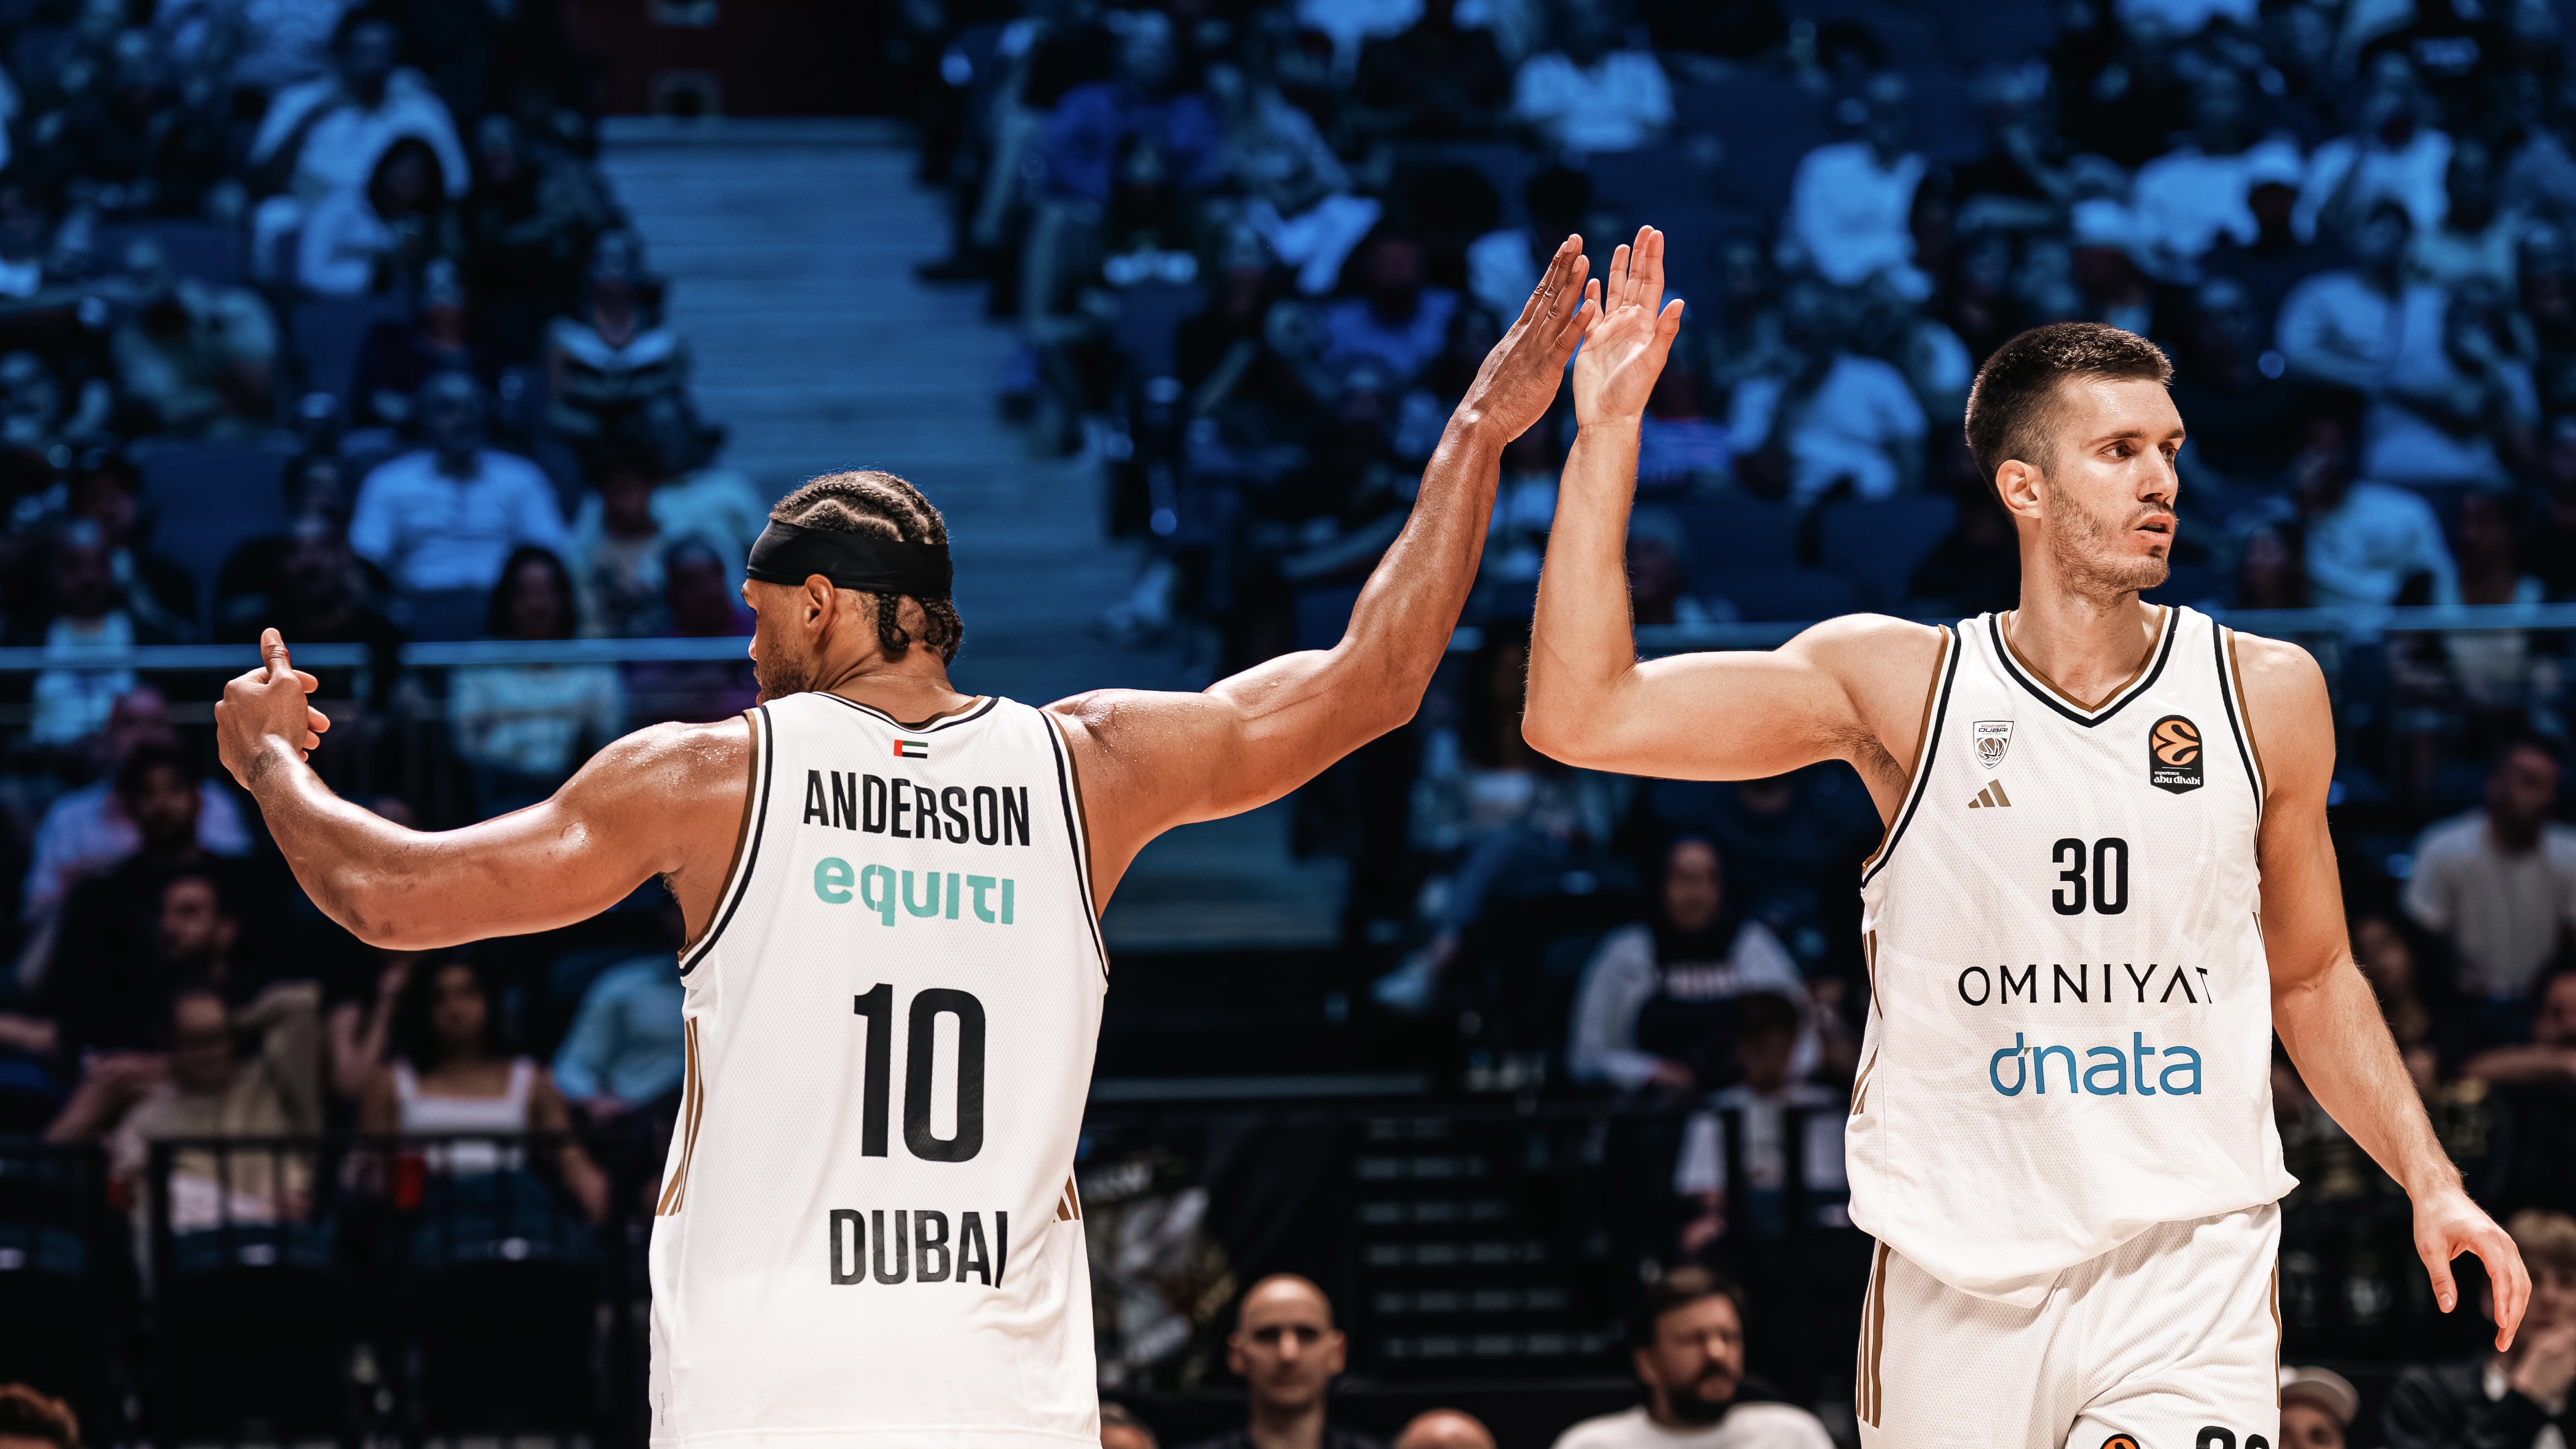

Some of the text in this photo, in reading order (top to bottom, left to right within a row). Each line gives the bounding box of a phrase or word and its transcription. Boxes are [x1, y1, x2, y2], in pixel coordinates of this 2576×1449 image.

[803, 769, 1030, 846] ANDERSON
[2154, 775, 2201, 785] abu dhabi
[814, 857, 1014, 926] equiti
[2052, 837, 2128, 915] 30
[854, 983, 986, 1163] 10
[1989, 1032, 2202, 1097] dnata
[830, 1209, 1008, 1289] DUBAI
